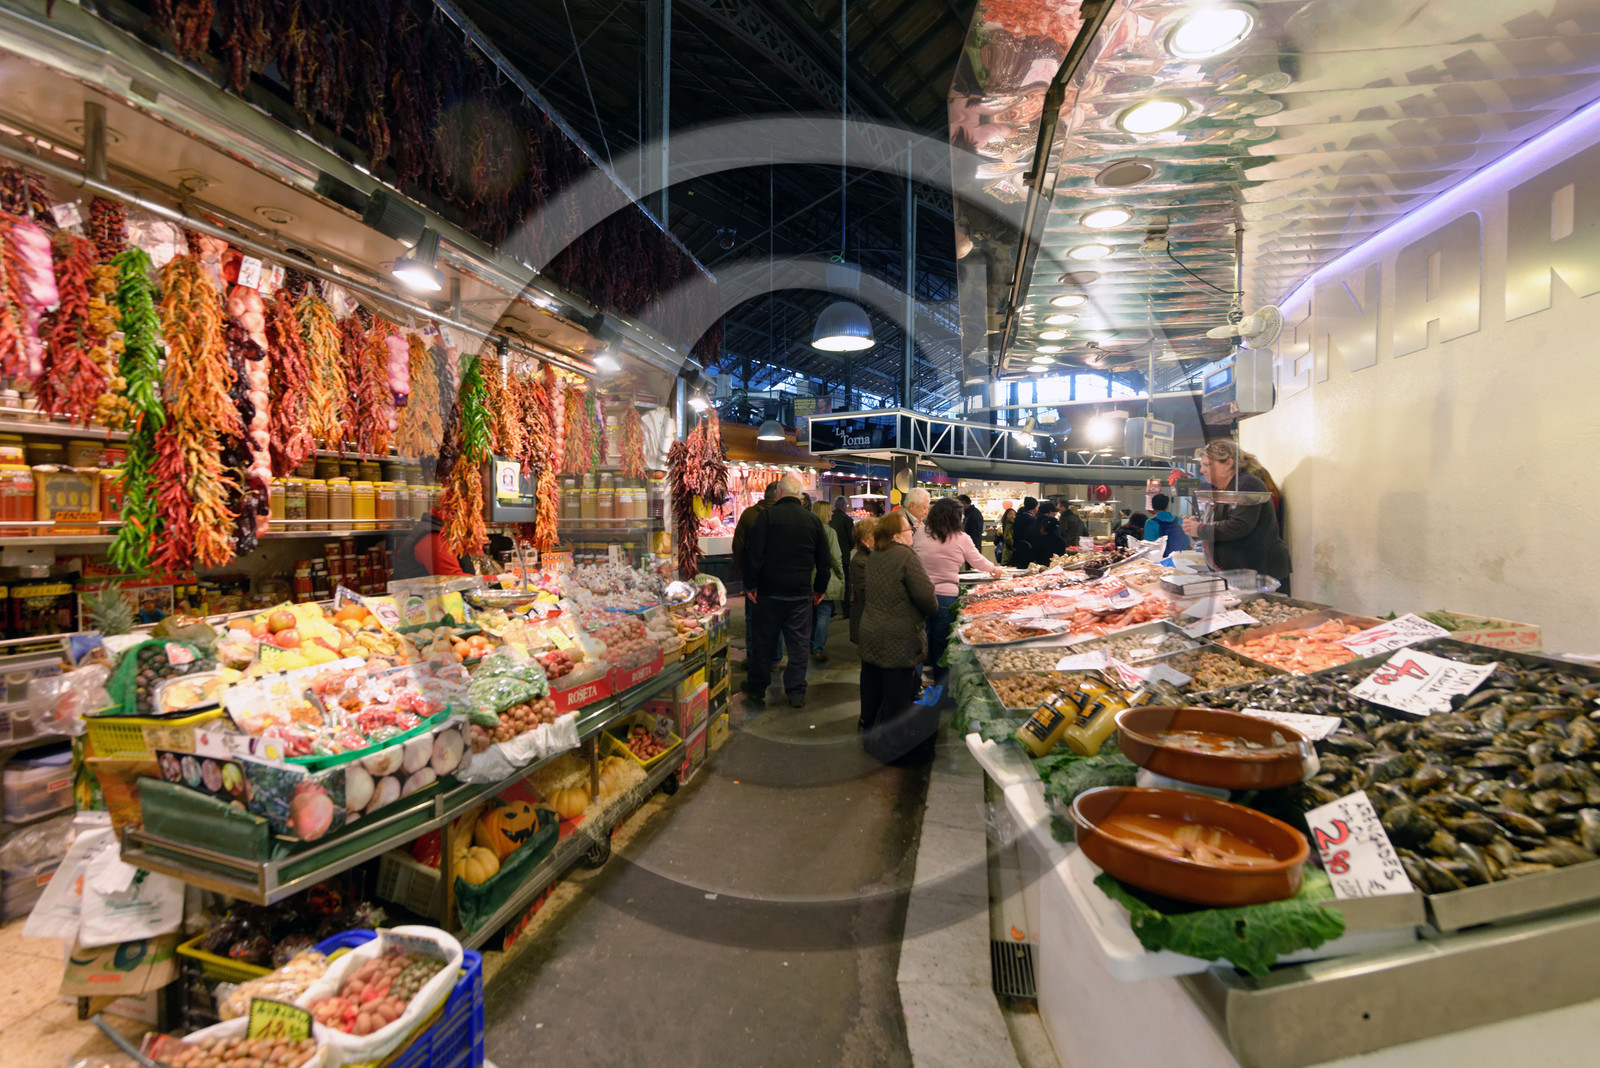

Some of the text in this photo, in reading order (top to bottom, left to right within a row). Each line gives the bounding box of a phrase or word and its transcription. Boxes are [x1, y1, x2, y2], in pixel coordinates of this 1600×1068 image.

[1274, 145, 1600, 402] ENAR
[835, 428, 845, 436] La
[841, 435, 871, 446] Torna
[632, 666, 651, 682] ROSETA
[567, 686, 597, 705] ROSETA
